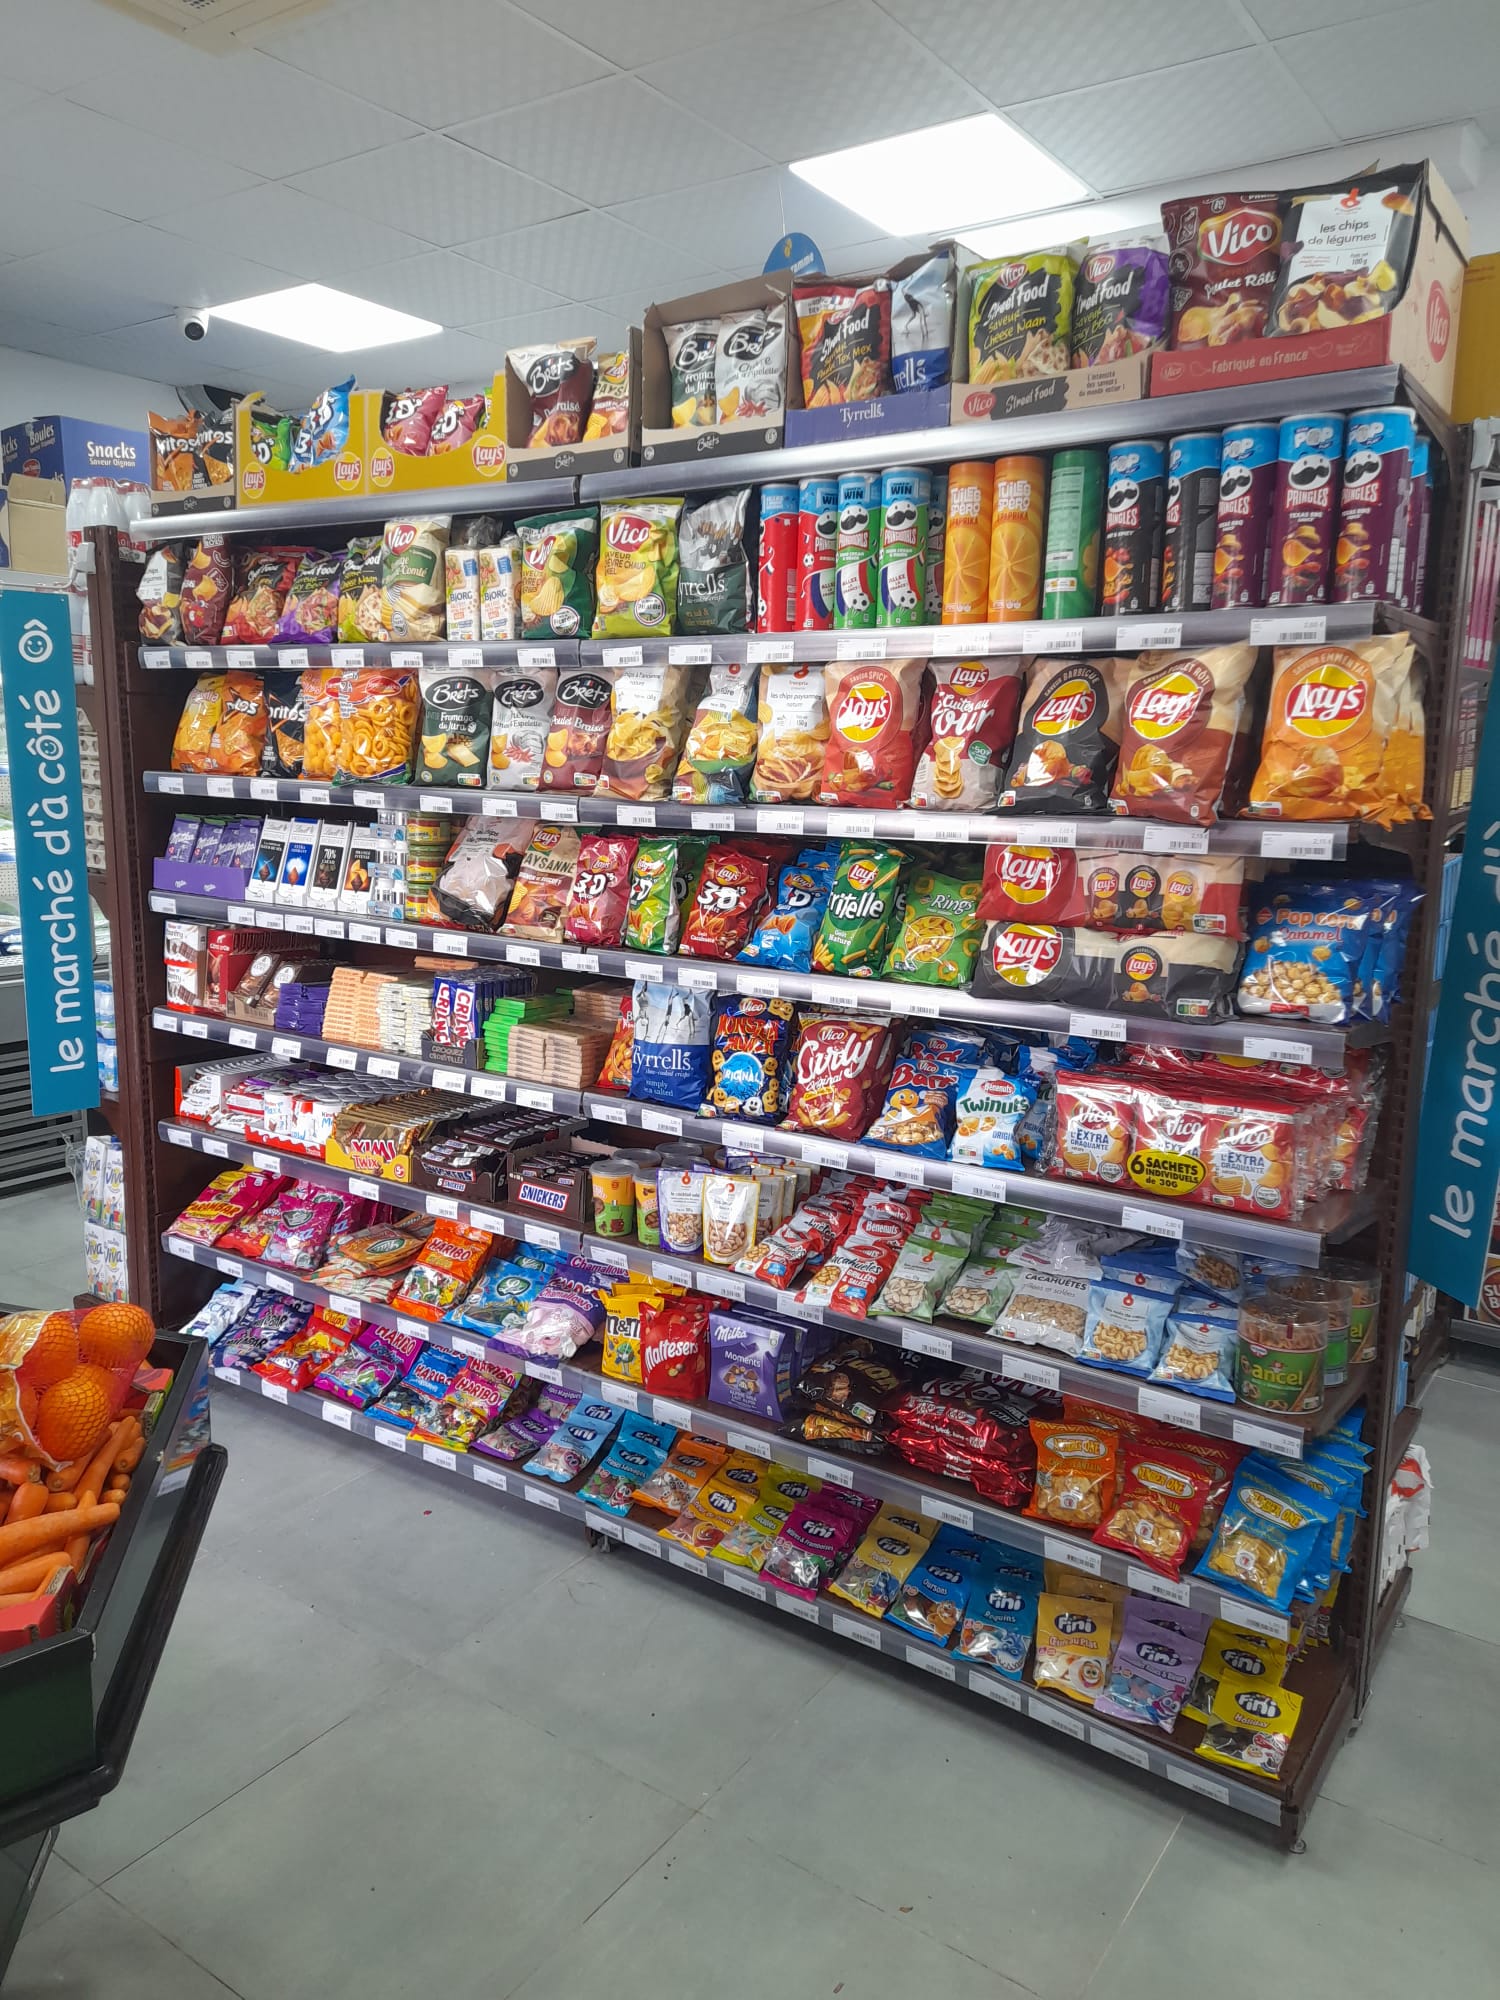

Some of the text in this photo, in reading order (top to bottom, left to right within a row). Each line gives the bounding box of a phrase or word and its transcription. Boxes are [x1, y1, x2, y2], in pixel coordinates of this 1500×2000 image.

[1319, 218, 1370, 234] les chips
[1207, 222, 1273, 258] Vico
[1308, 231, 1377, 248] de légumes
[1000, 265, 1026, 287] Vico
[1088, 258, 1113, 281] Vico
[1017, 272, 1049, 304] Food
[1099, 271, 1134, 302] Food
[842, 309, 869, 338] Food
[1016, 315, 1047, 334] Naan
[1428, 300, 1449, 346] Vico
[1259, 356, 1273, 367] en
[1274, 350, 1309, 364] France
[530, 352, 574, 393] Brets
[1033, 381, 1055, 402] Food
[967, 397, 993, 415] Vico
[86, 441, 136, 459] Snacks
[472, 443, 504, 468] Lay's
[335, 459, 361, 481] Lay's
[370, 458, 394, 479] Lay's
[243, 470, 265, 489] Lay's
[891, 484, 913, 495] WIN
[844, 489, 864, 500] WIN
[1286, 486, 1329, 508] PRINGLES
[387, 528, 412, 550] Vico
[606, 519, 650, 544] Vico
[315, 562, 340, 576] Food
[401, 565, 428, 577] Comté
[1319, 652, 1370, 677] EMMENTAL
[868, 670, 888, 683] SPICY
[952, 668, 988, 688] Lay's
[433, 681, 480, 704] Brets
[561, 678, 610, 705] Brets
[836, 692, 892, 731] Lay's
[942, 694, 973, 712] Cuites
[1036, 690, 1093, 722] Lay's
[1132, 688, 1195, 726] Lay's
[1291, 683, 1363, 721] Lay's
[440, 711, 474, 722] Fromage
[18, 687, 65, 786] côté
[28, 793, 71, 857] d'à
[534, 830, 561, 850] Lay's
[323, 848, 337, 859] 70%
[716, 866, 741, 883] Lay's
[850, 865, 877, 886] Lay's
[1001, 852, 1056, 891] Lay's
[1092, 876, 1117, 893] Lay's
[1130, 876, 1156, 892] Lay's
[1169, 880, 1194, 897] Lay's
[932, 896, 974, 915] Rings
[1275, 908, 1314, 927] Pop
[1280, 926, 1345, 943] Caramel
[32, 868, 82, 1024] marché
[997, 933, 1061, 974] Lay's
[1128, 959, 1158, 975] Lay's
[820, 1029, 845, 1042] Vico
[49, 1036, 85, 1073] le
[919, 1061, 938, 1073] Vico
[959, 1097, 1030, 1114] Twinuts
[1165, 1113, 1202, 1137] Vico
[352, 1154, 380, 1169] Twix
[1130, 1158, 1199, 1175] 6 SACHETS
[1221, 1151, 1266, 1168] L'EXTRA
[1221, 1161, 1266, 1175] CRAQUANTE
[443, 1179, 466, 1192] SNICKERS
[1145, 1168, 1200, 1184] INDIVIDUELS
[1145, 1177, 1178, 1189] de 30G
[520, 1184, 567, 1210] SNICKERS
[1430, 1184, 1474, 1240] le
[426, 1237, 472, 1262] HARIBO
[570, 1255, 630, 1278] Chamallows
[540, 1288, 592, 1312] Chamallows
[376, 1325, 417, 1357] HARIBO
[714, 1325, 748, 1342] Milka
[644, 1339, 699, 1371] Maltesers
[724, 1350, 762, 1368] Moments
[1251, 1361, 1304, 1387] ancel
[456, 1376, 499, 1406] HARIBO
[557, 1387, 582, 1400] Magiques
[585, 1404, 612, 1420] Fini
[1082, 1436, 1100, 1455] ONE
[620, 1449, 649, 1467] Fini
[727, 1468, 757, 1484] Fini
[1136, 1464, 1187, 1497] NUMBER ONE
[779, 1482, 809, 1499] Fini
[709, 1491, 737, 1513] Fini
[1249, 1488, 1304, 1529] NUMBER ONE
[802, 1520, 836, 1540] Fini
[877, 1537, 910, 1556] Fini
[927, 1565, 964, 1583] Fini
[922, 1578, 949, 1596] Oursons
[988, 1591, 1022, 1611] Fini
[984, 1610, 1017, 1624] Requins
[1057, 1614, 1093, 1634] Fini
[1137, 1643, 1181, 1667] Fini
[1223, 1650, 1261, 1673] Fini
[1237, 1693, 1279, 1719] Fini
[1233, 1712, 1270, 1729] Holiday
